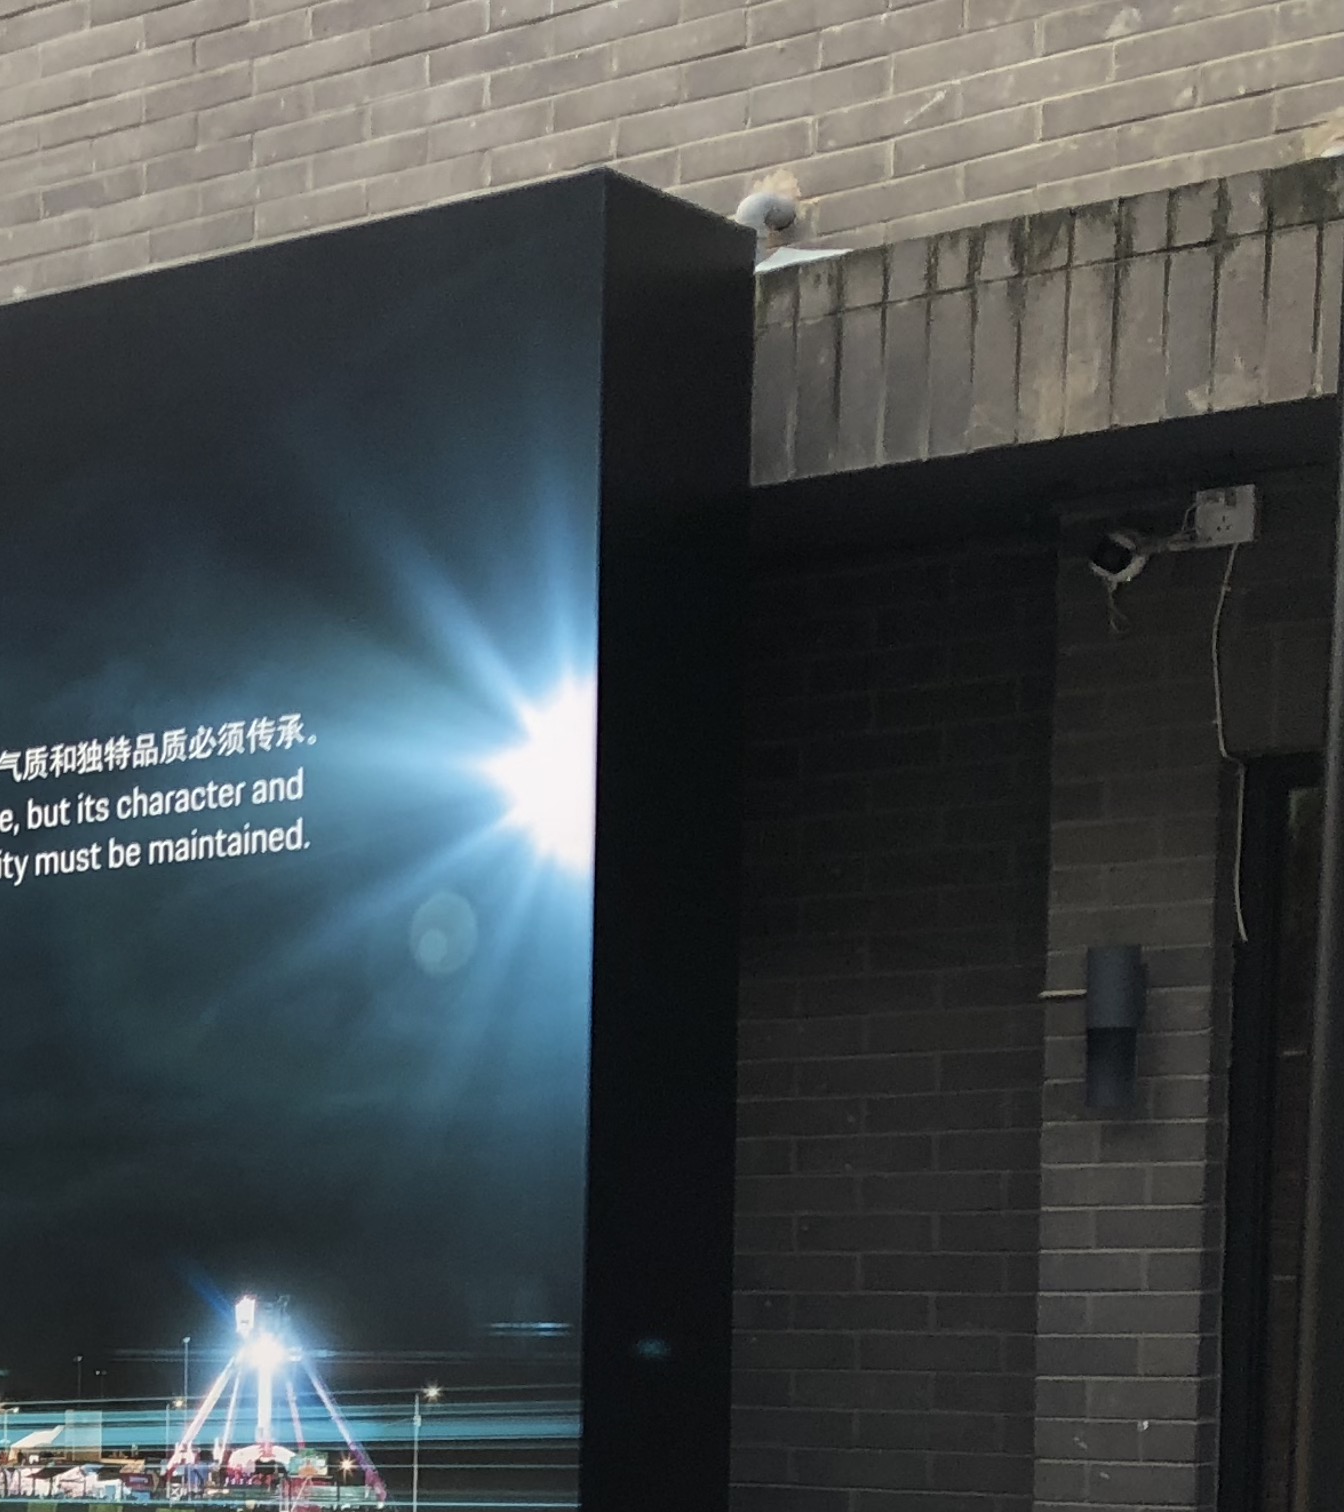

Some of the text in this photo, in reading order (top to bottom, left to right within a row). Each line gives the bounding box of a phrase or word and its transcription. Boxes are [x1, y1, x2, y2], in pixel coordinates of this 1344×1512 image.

[27, 798, 71, 830] but
[77, 792, 110, 825] its
[116, 780, 246, 820] character
[252, 767, 305, 806] and
[35, 843, 101, 877] must
[108, 838, 141, 868] be
[148, 817, 311, 866] maintained.
